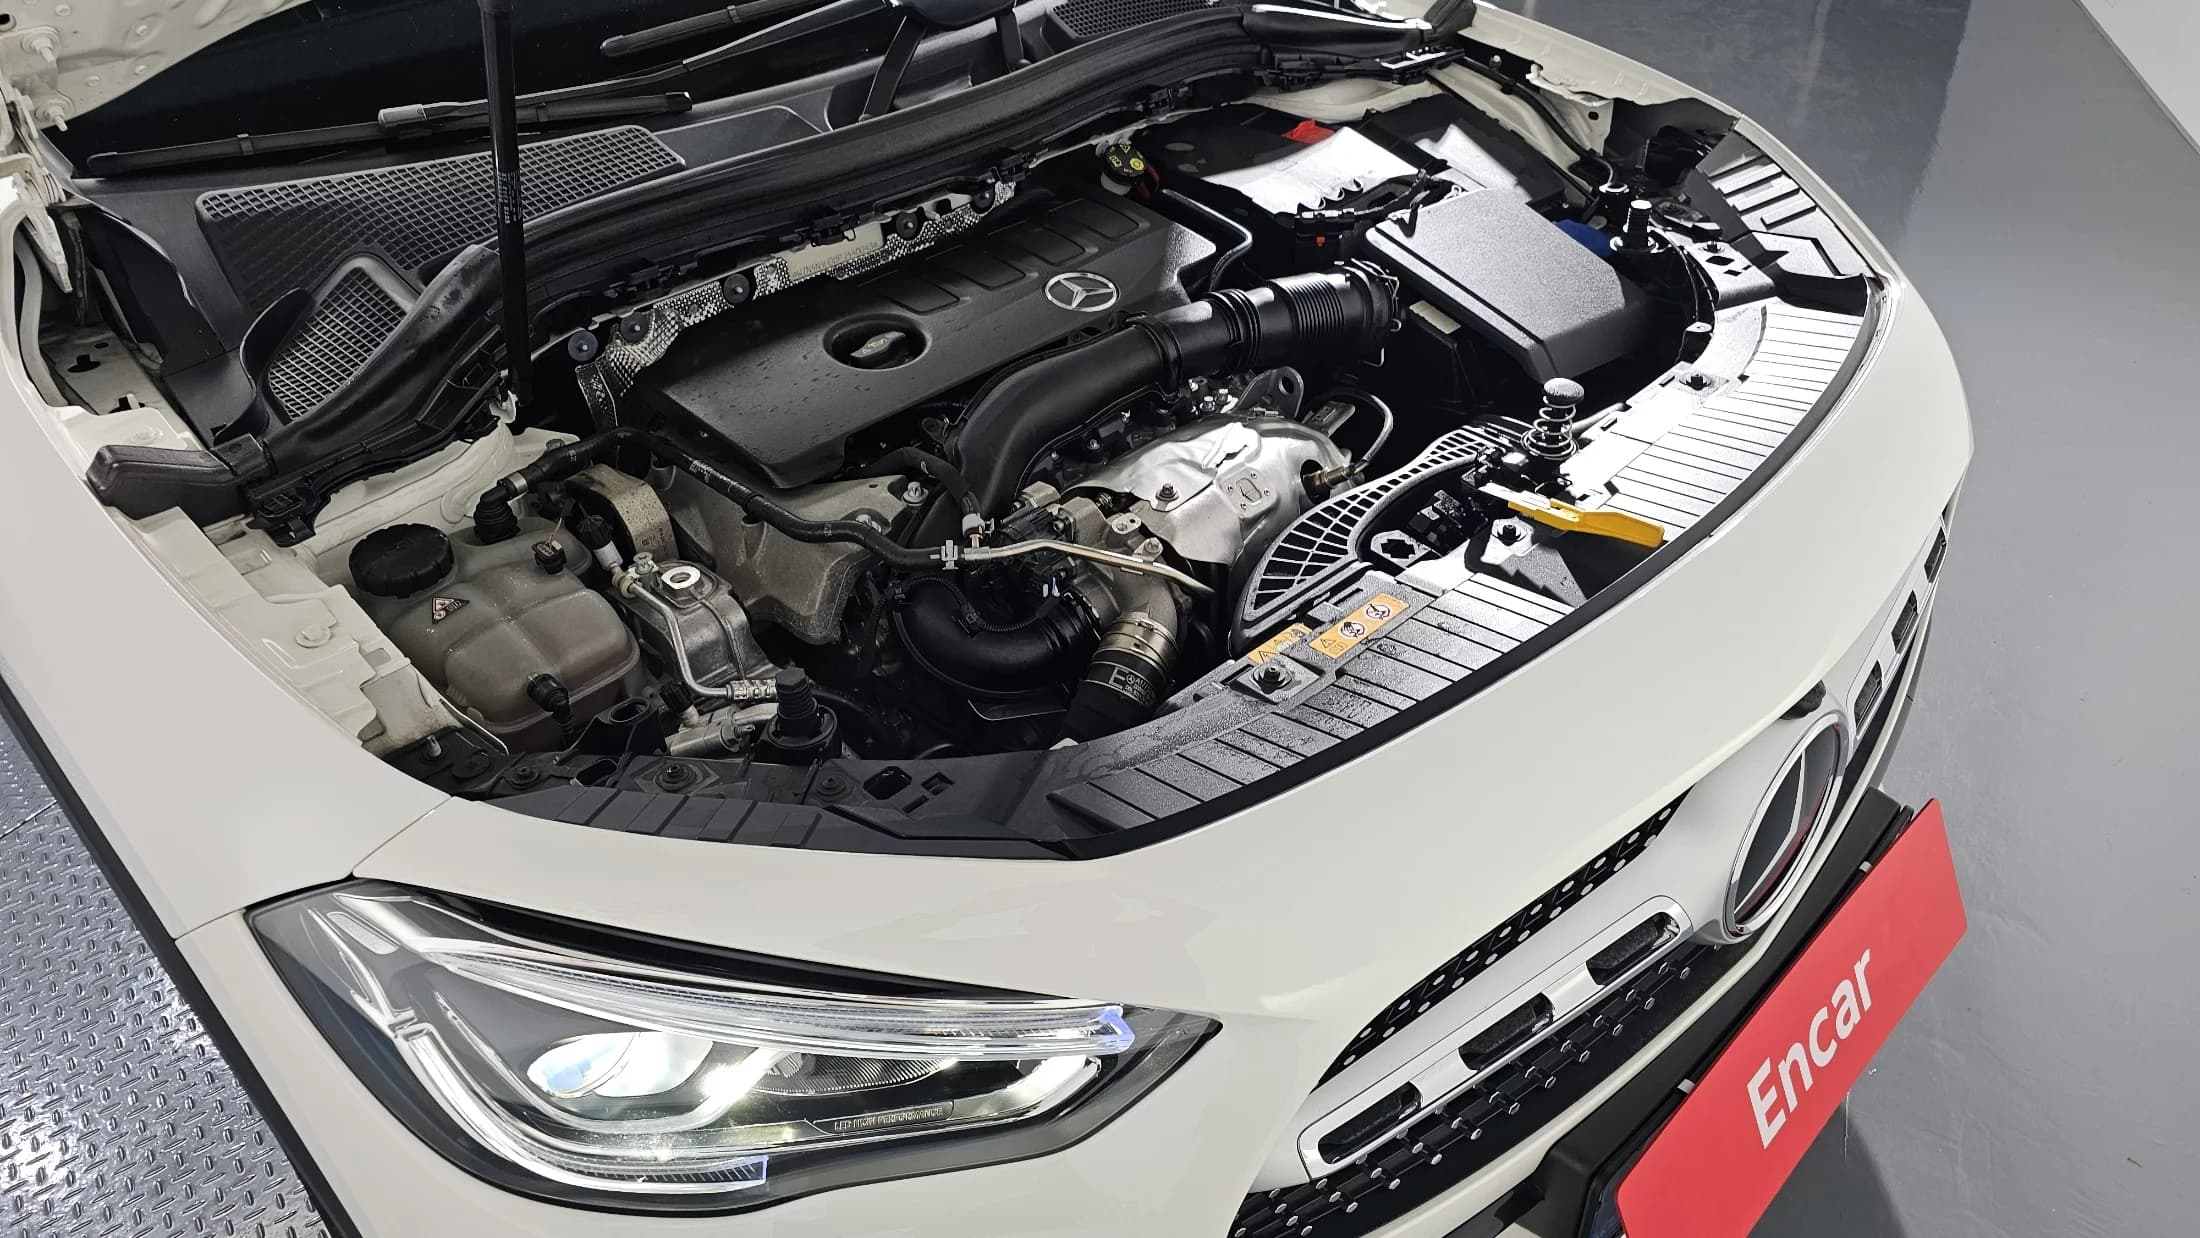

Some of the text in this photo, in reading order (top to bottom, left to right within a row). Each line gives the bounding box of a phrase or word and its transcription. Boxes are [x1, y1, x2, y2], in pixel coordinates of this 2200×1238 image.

[1747, 949, 1871, 1149] Encar
[834, 1107, 943, 1131] LED HIGH PERFORMANCE
